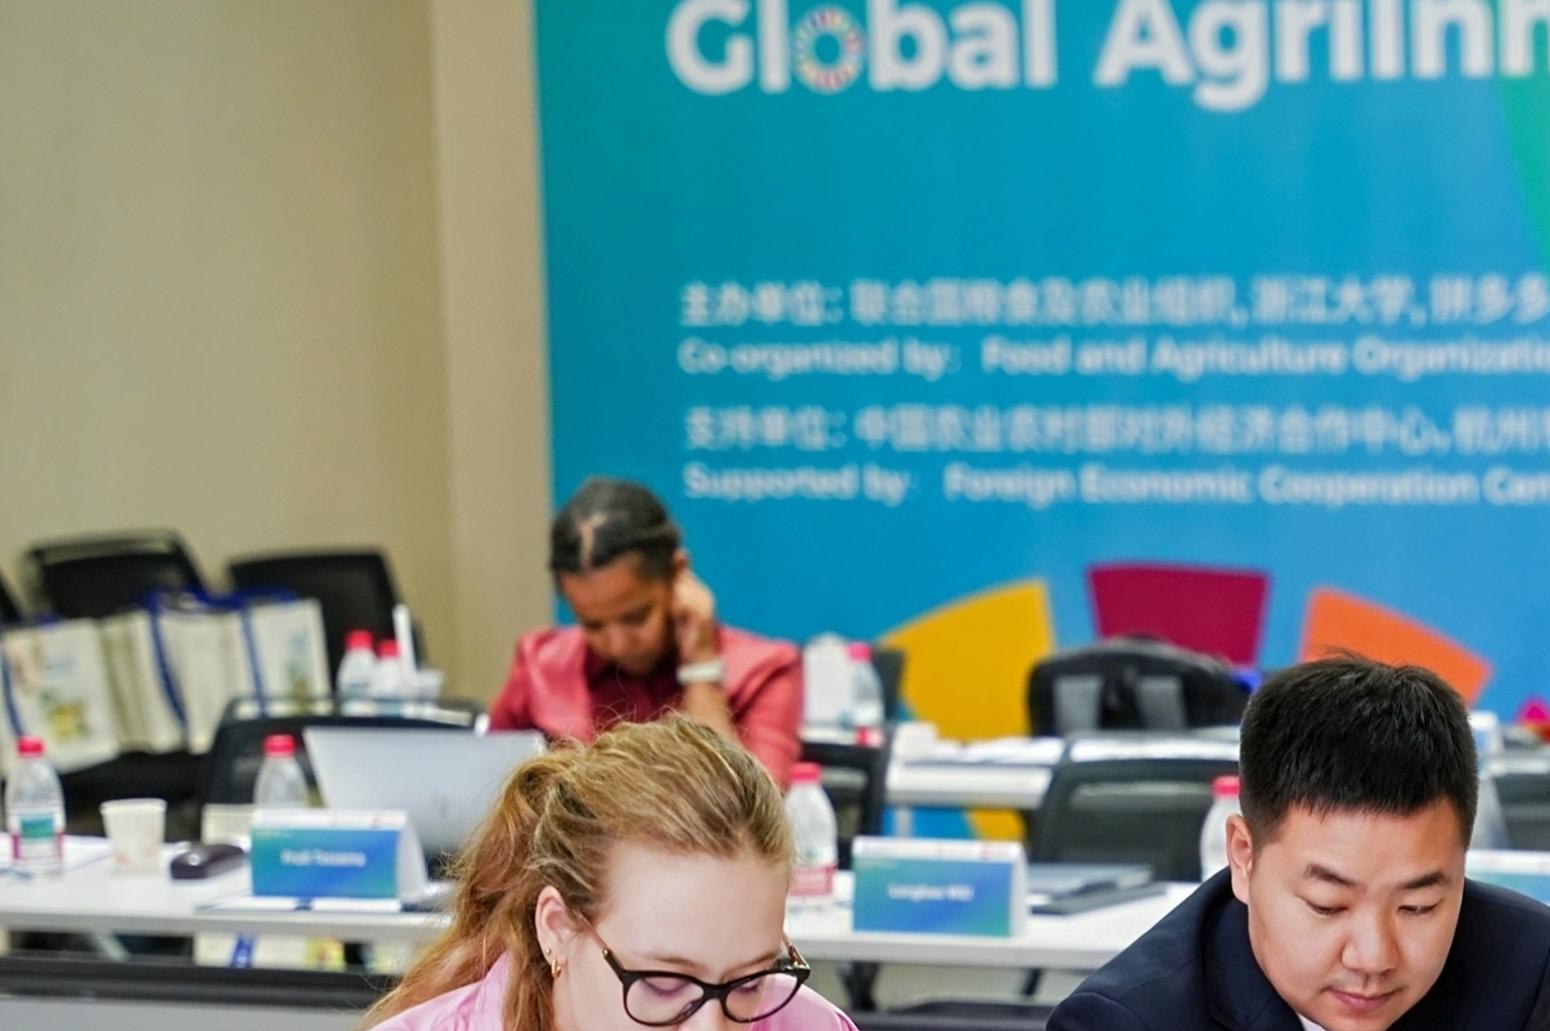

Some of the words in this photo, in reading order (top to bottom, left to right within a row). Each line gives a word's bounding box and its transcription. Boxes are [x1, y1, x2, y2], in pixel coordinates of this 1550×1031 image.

[665, 0, 1058, 95] Global
[679, 336, 898, 380] Co-organized
[982, 334, 1071, 376] Food
[1075, 336, 1147, 376] and
[1152, 335, 1347, 382] Agriculture
[683, 461, 860, 500] Supported
[944, 461, 1076, 509] Foreign
[1080, 462, 1250, 503] Economic
[1259, 464, 1480, 509] Cooperation
